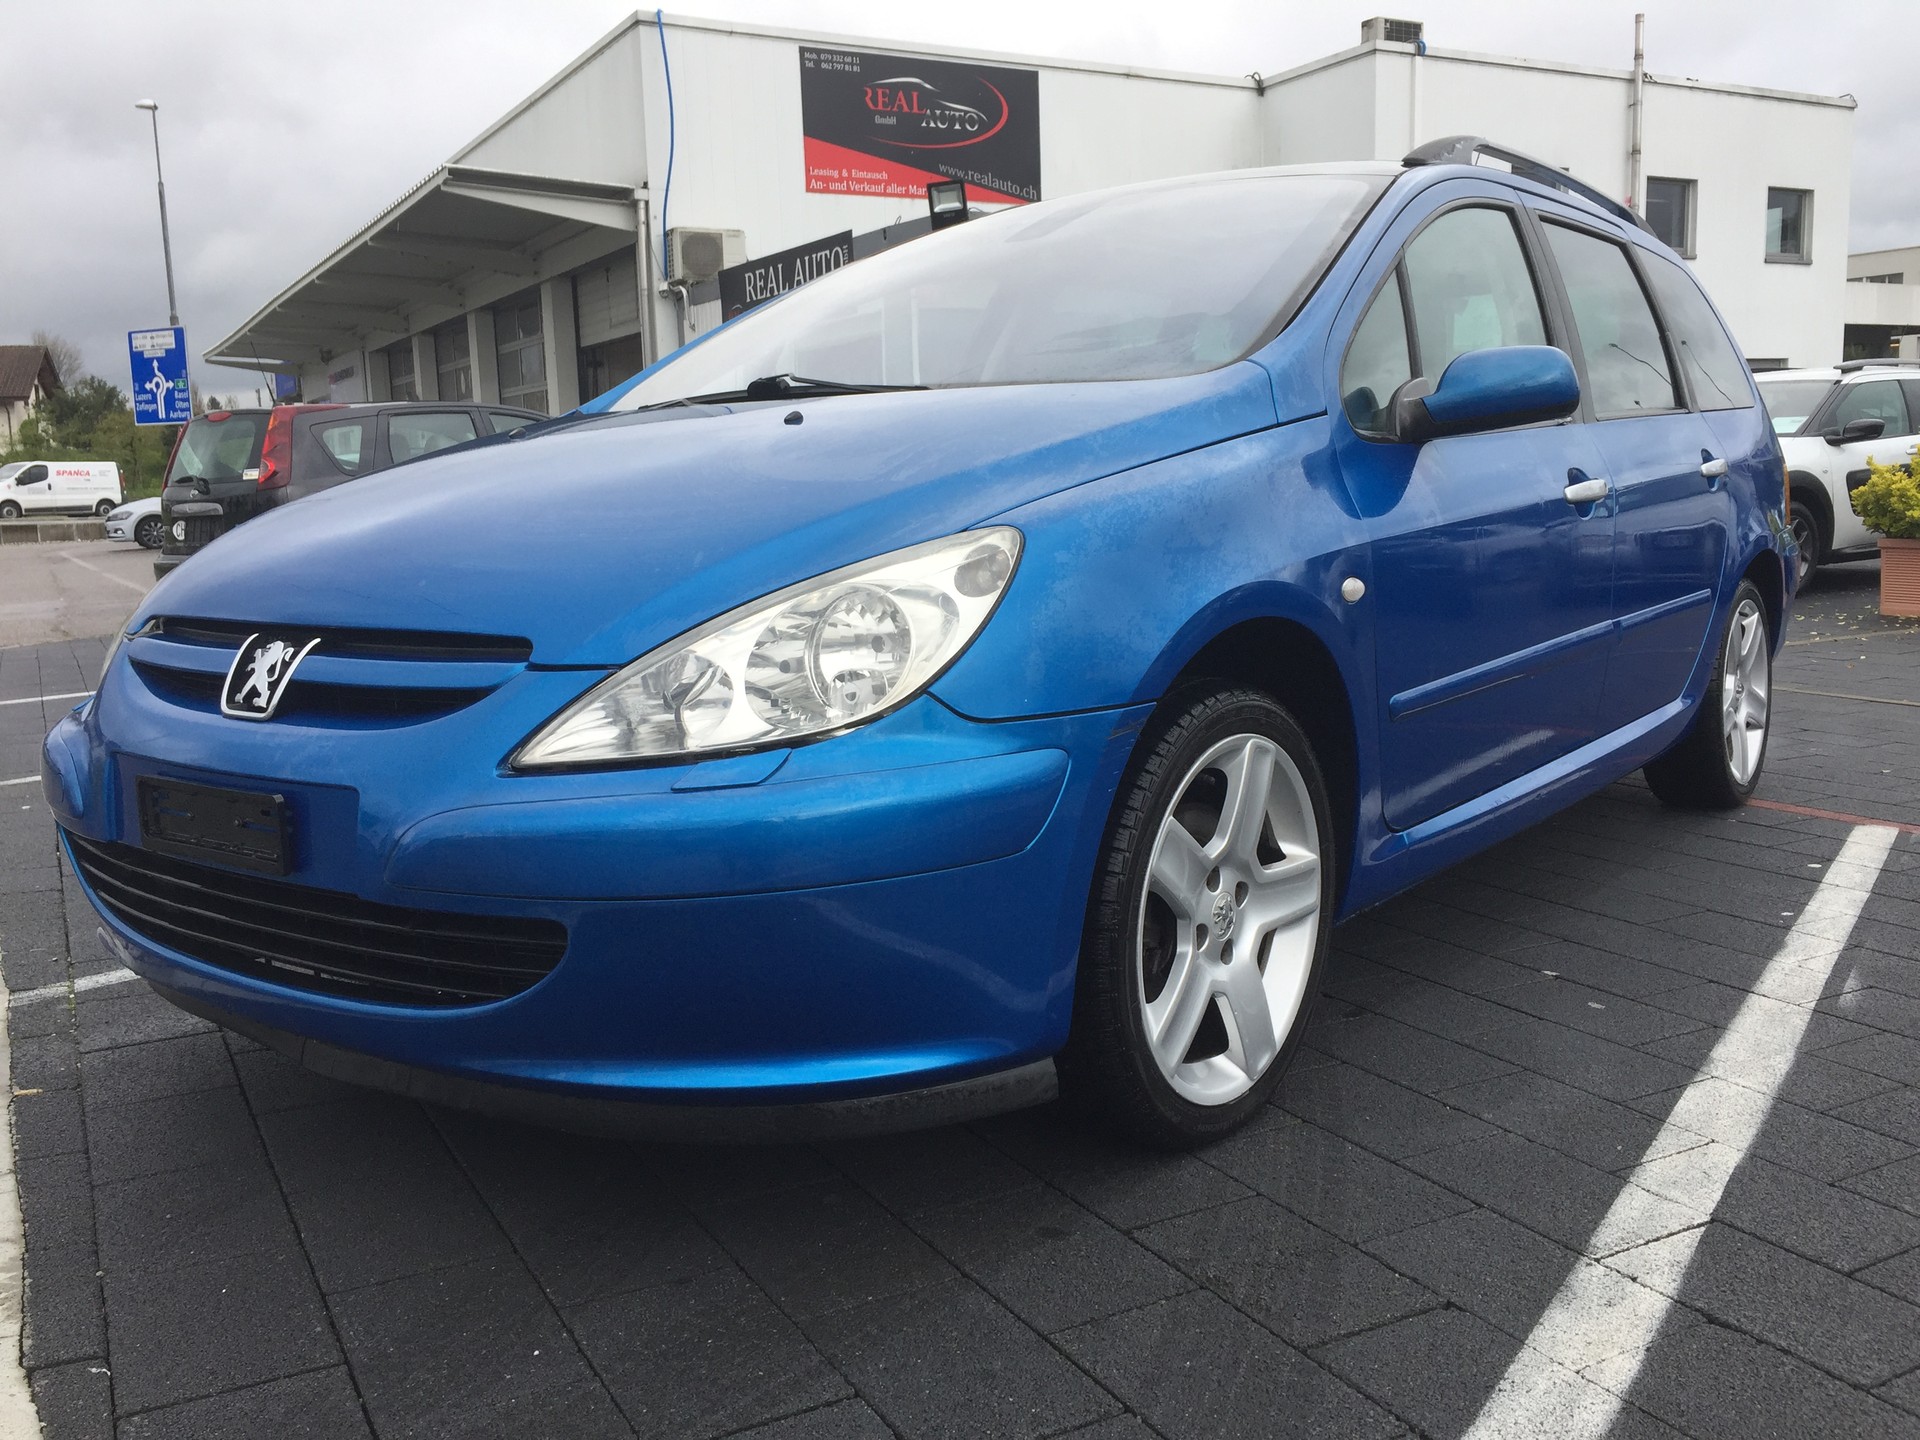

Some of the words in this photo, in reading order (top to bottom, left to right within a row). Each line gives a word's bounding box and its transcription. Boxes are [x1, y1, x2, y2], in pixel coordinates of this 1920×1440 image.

[864, 86, 927, 114] REAL
[875, 114, 897, 125] GmbH
[921, 109, 979, 131] AUTO
[809, 166, 839, 178] Leasing
[842, 169, 848, 177] &
[852, 169, 888, 180] Eintausch
[939, 163, 1037, 200] www.realauto.ch
[810, 179, 827, 190] An-
[829, 180, 847, 191] und
[849, 181, 885, 193] Verkauf
[886, 183, 907, 194] aller
[793, 246, 844, 289] AUTO
[744, 263, 789, 303] REAL
